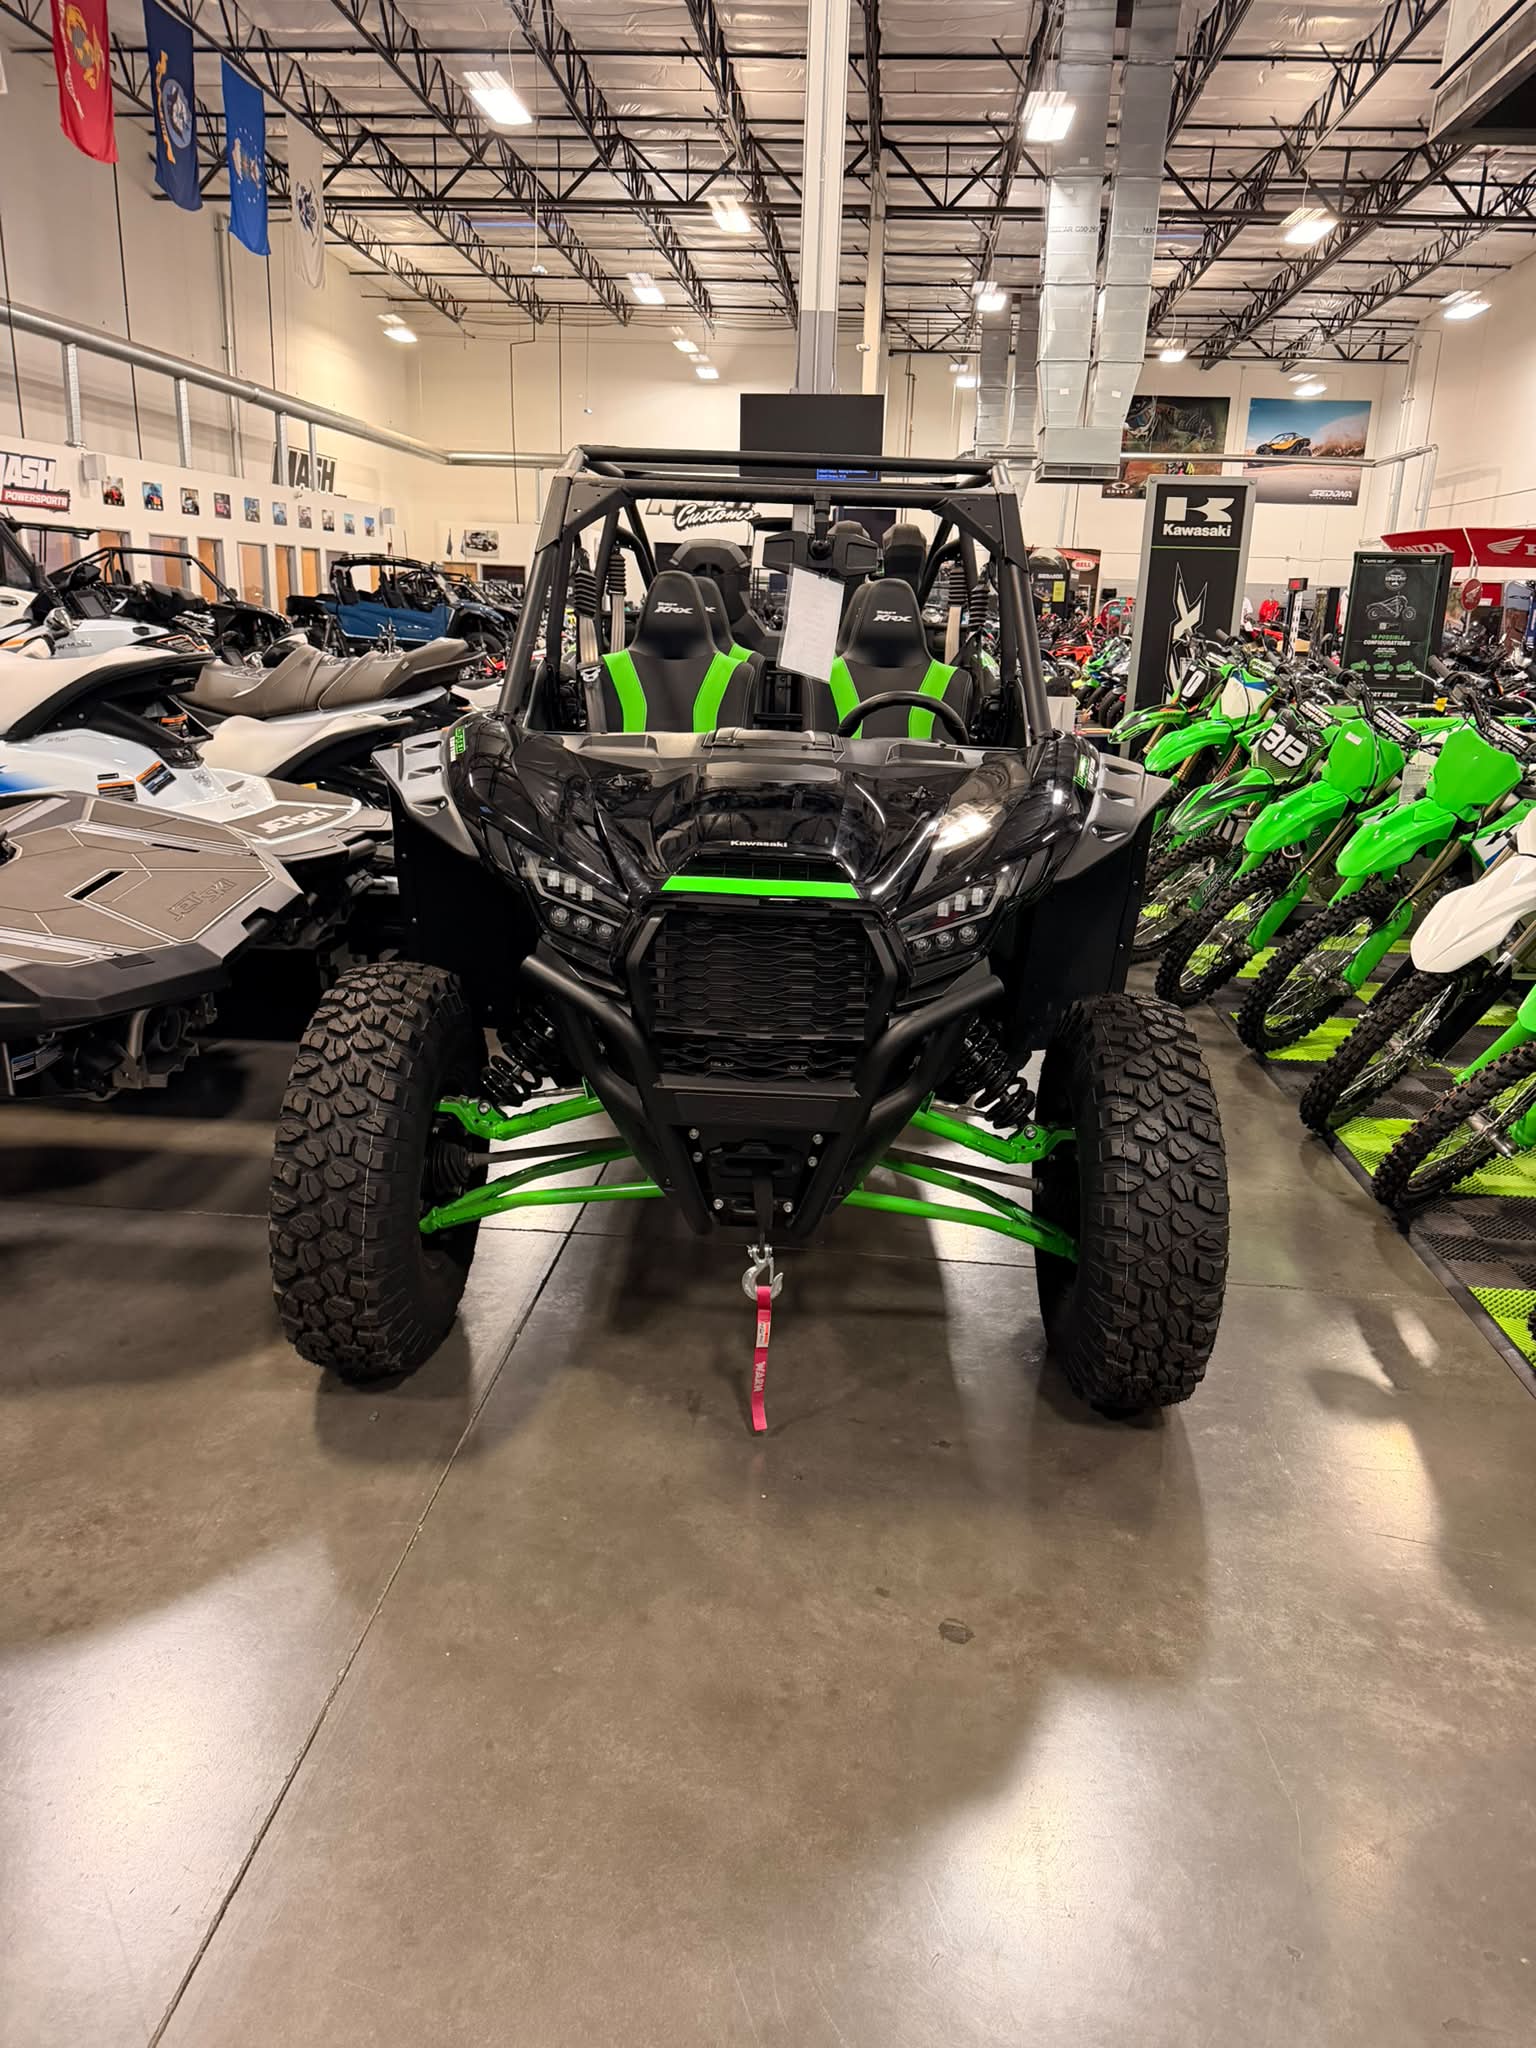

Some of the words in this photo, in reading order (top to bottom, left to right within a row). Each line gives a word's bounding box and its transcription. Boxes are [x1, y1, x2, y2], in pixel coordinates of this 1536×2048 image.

[676, 503, 758, 528] Customs
[1162, 524, 1232, 537] Kawasaki
[654, 606, 694, 614] KRX
[873, 614, 912, 622] KRX
[730, 840, 789, 848] Kawasaki
[753, 1361, 766, 1392] WARN
